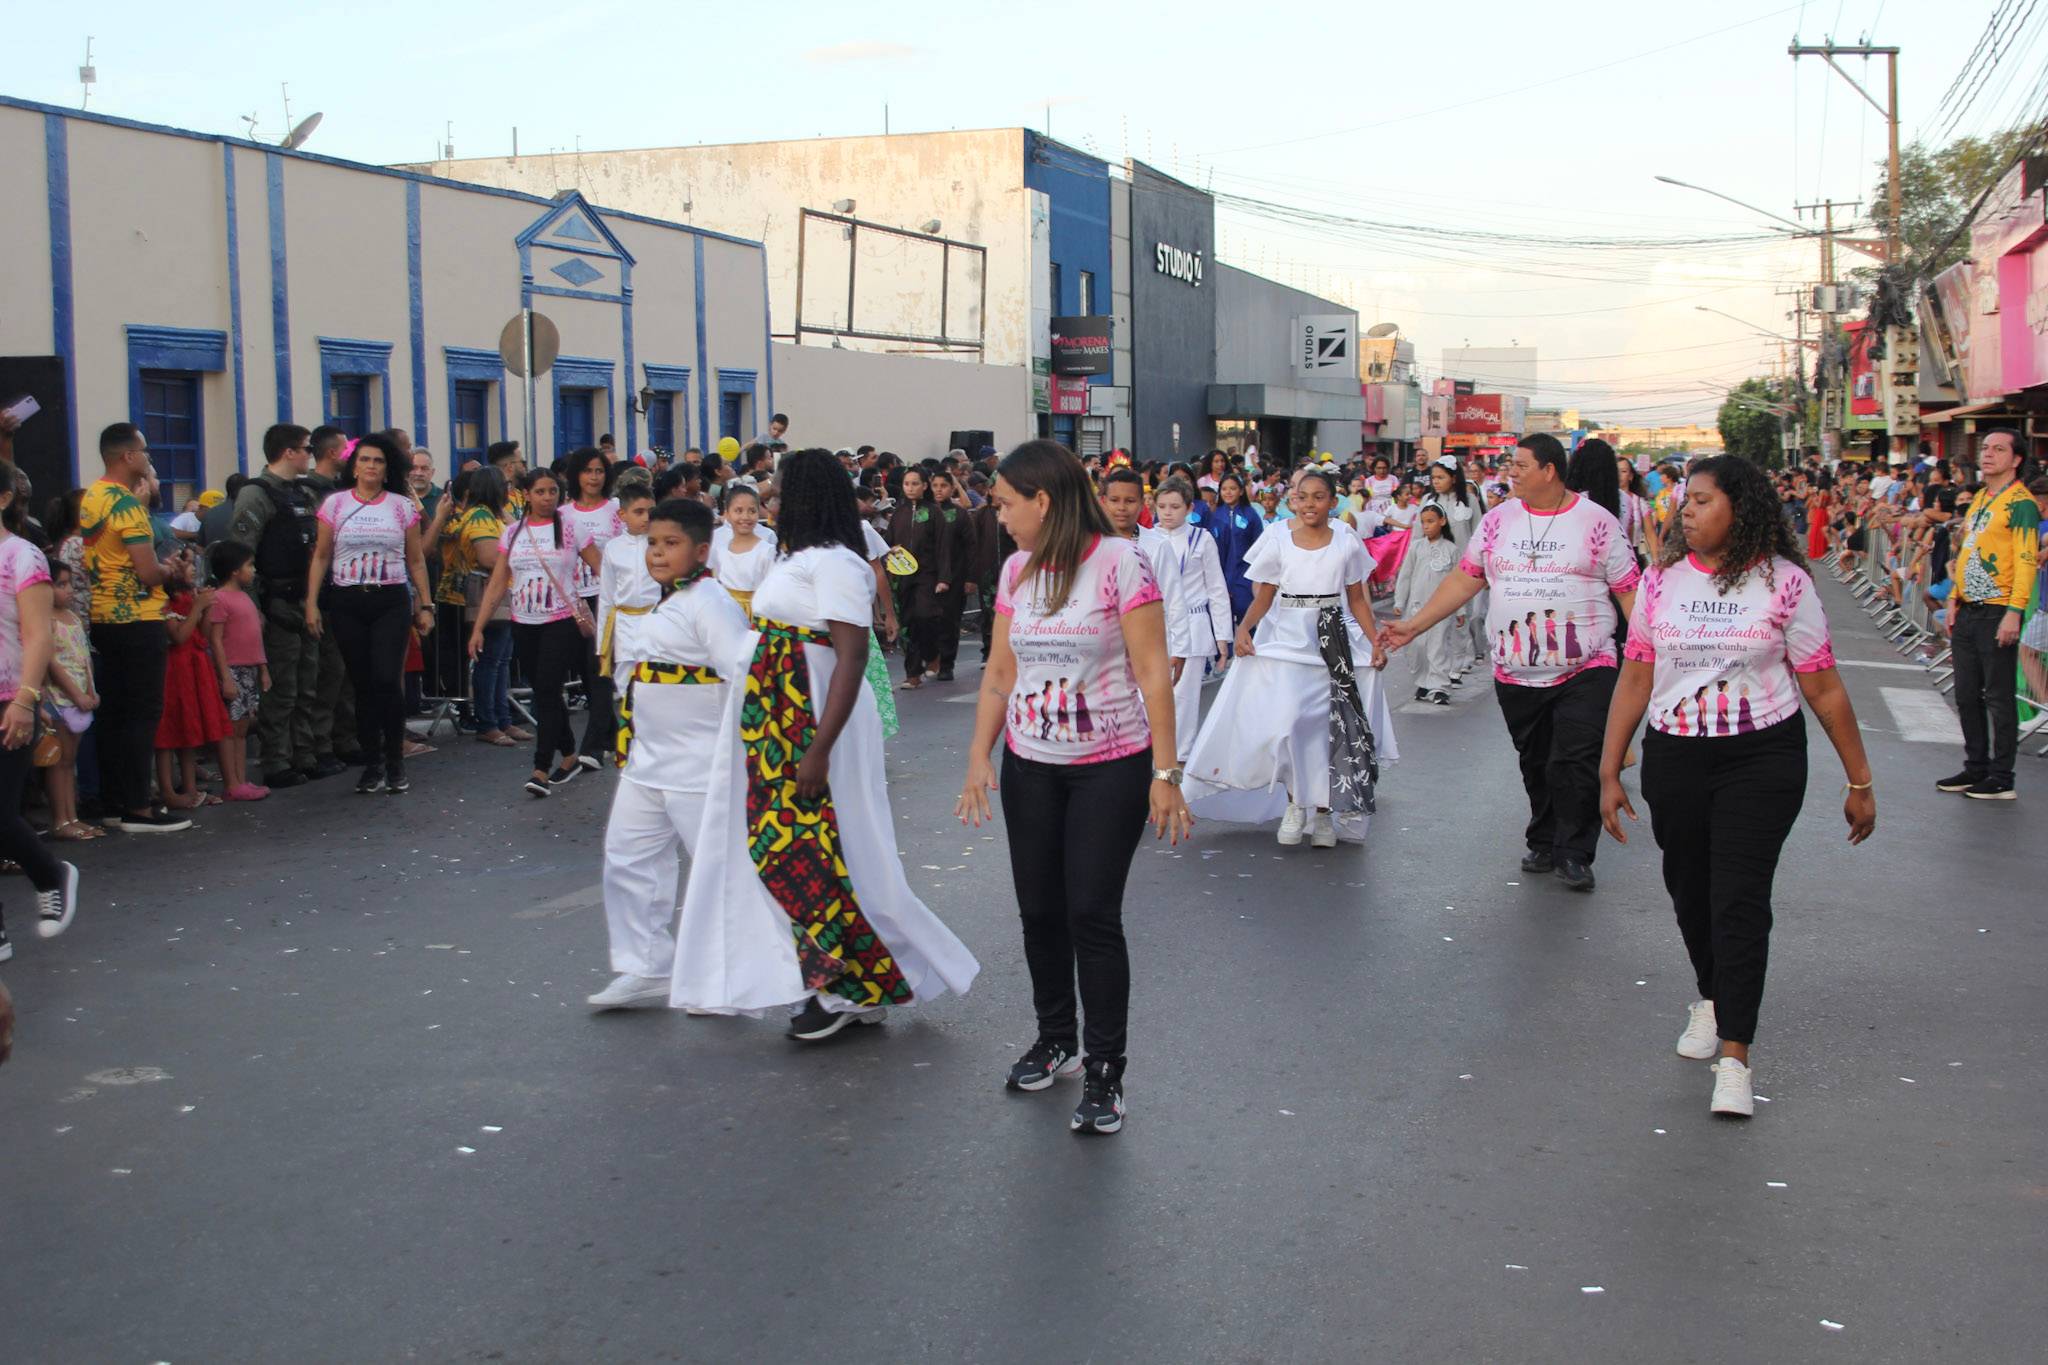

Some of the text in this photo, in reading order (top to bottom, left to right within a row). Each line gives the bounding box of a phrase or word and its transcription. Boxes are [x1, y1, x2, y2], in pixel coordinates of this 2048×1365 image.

[1157, 242, 1193, 282] STUDIO
[1083, 345, 1109, 355] MAKES
[1305, 325, 1314, 369] STUDIO
[1456, 411, 1501, 422] TROPICAL
[1521, 540, 1557, 551] EMEB
[1495, 555, 1514, 574] Rita
[1534, 588, 1566, 598] Mulher
[1691, 600, 1738, 615] EMEB
[1688, 614, 1733, 623] Professora
[1024, 619, 1099, 635] Auxiliadora
[1655, 622, 1772, 640] Rita Auxiliadora
[1020, 639, 1049, 648] Campos
[1050, 639, 1077, 648] Cunha
[1667, 642, 1748, 652] de Campos Cunha
[1047, 652, 1080, 664] Mulher
[1671, 657, 1696, 669] Fases
[1698, 658, 1710, 667] da
